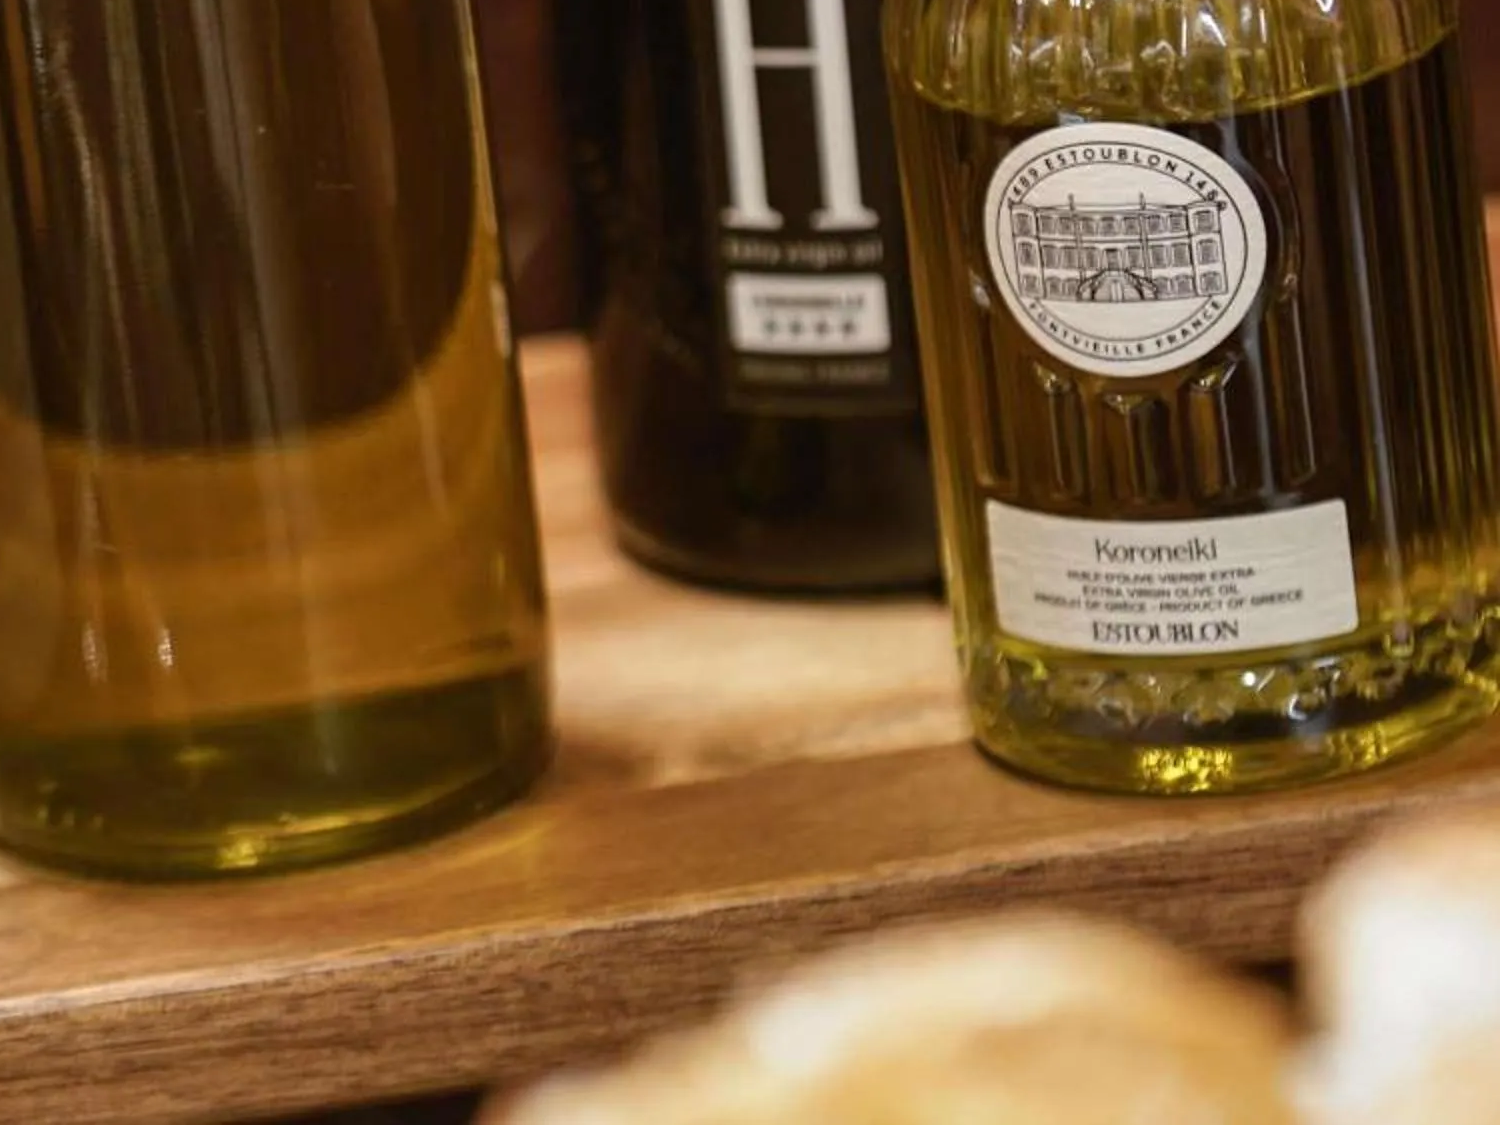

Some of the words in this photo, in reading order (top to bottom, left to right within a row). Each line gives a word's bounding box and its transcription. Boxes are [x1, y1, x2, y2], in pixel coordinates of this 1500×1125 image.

[1044, 148, 1178, 172] ESTOUBLON
[1156, 300, 1221, 349] FRANCE
[1095, 537, 1217, 563] Koroneiki
[1082, 585, 1123, 597] EXTRA
[1174, 586, 1212, 597] OLIVE
[1159, 600, 1222, 613] PRODUCT
[1092, 619, 1239, 644] ESTOUBLON
